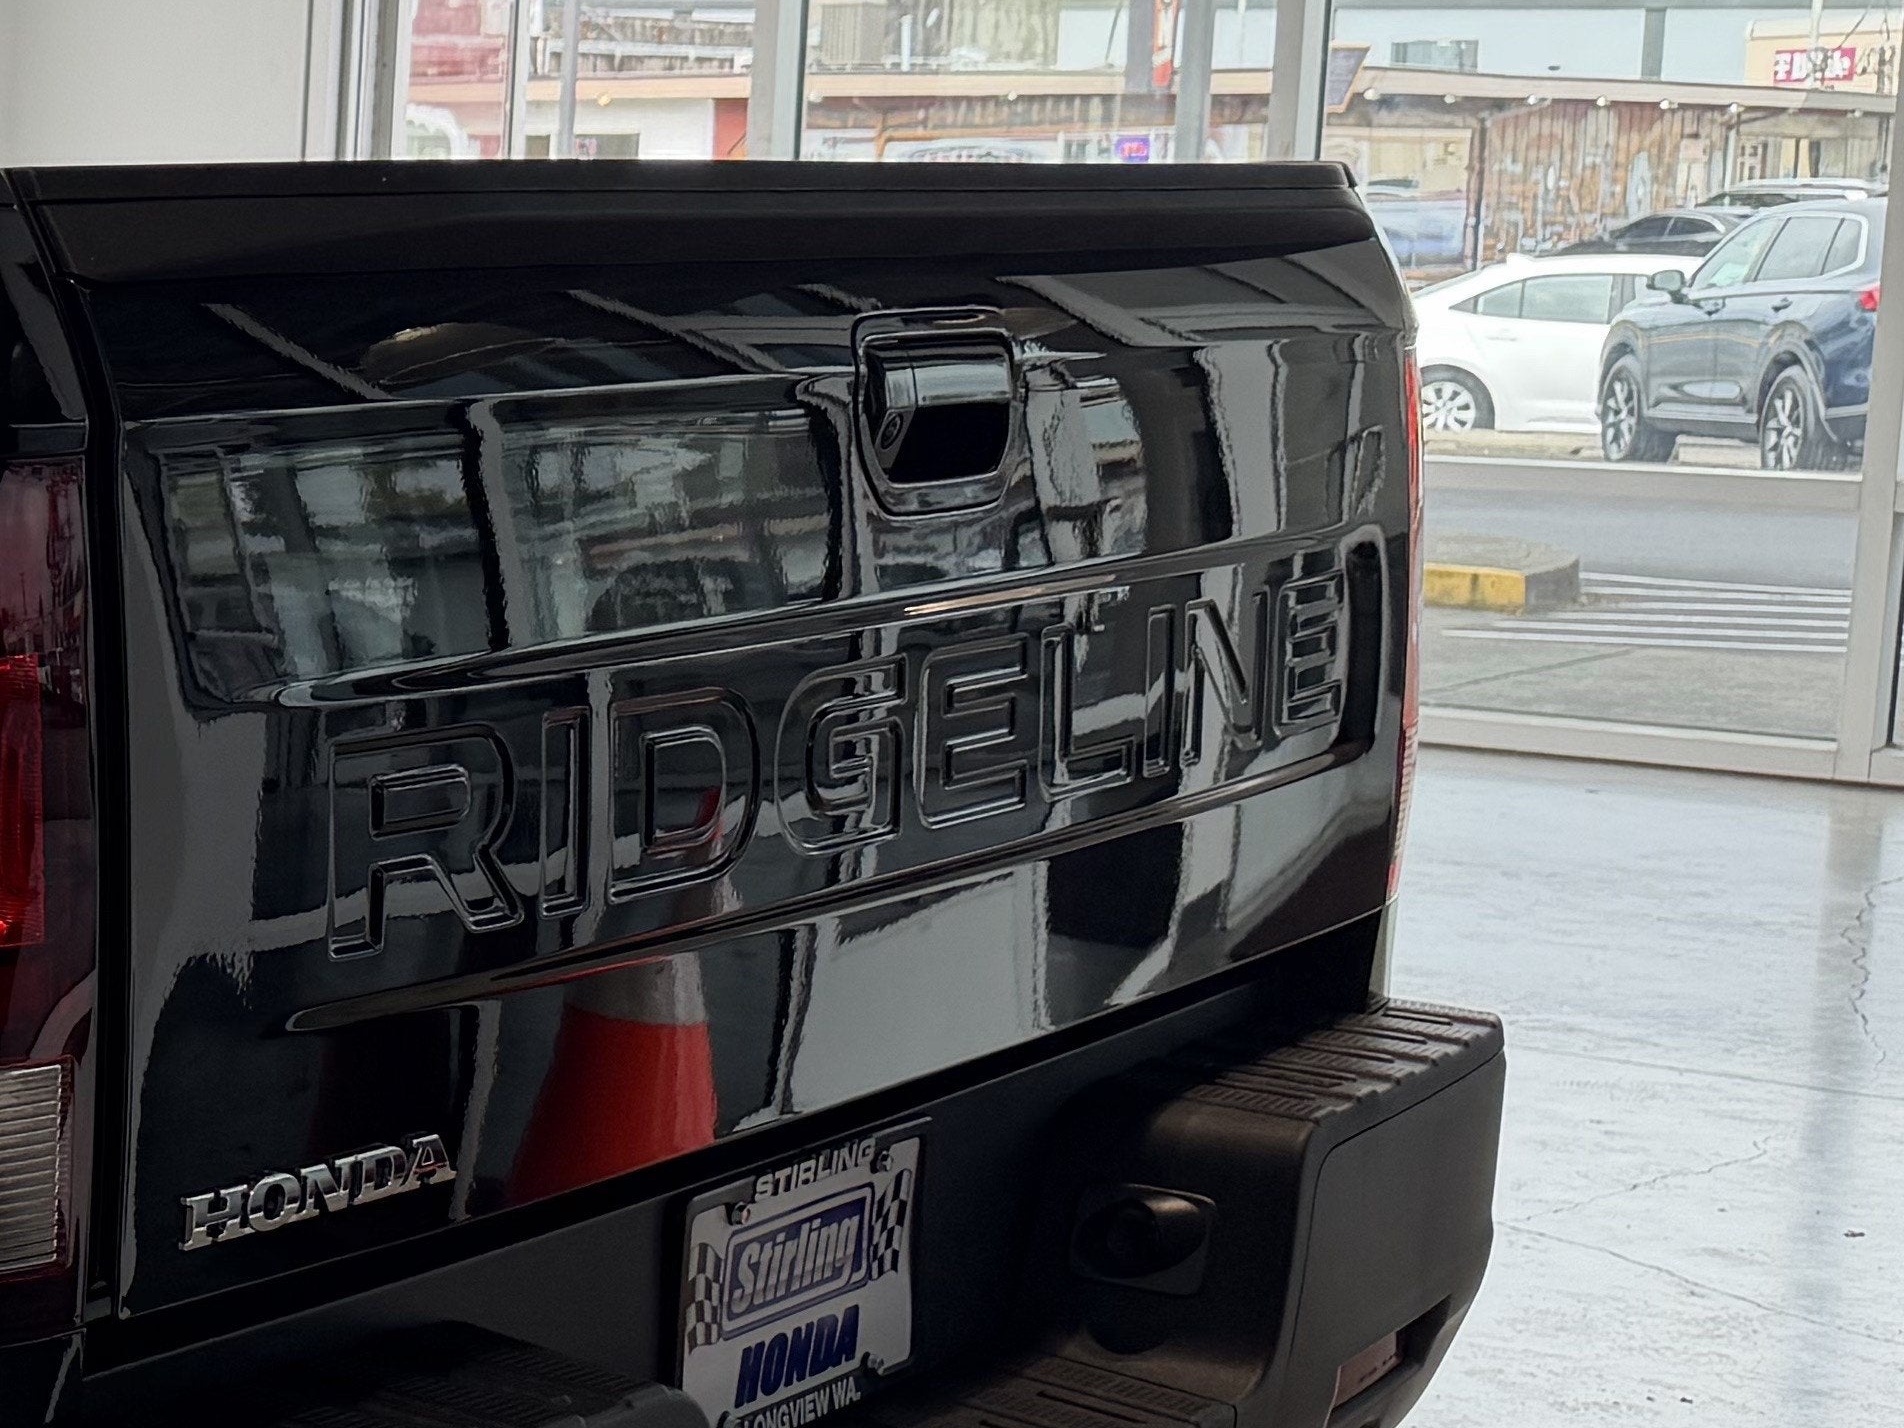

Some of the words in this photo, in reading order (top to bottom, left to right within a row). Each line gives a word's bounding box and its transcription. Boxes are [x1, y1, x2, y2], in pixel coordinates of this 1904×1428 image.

[326, 572, 1343, 959] RIDGELINE
[180, 1133, 457, 1252] HONDA
[754, 1137, 877, 1203] STIRLING
[731, 1214, 861, 1314] Stirling
[734, 1304, 860, 1409] HONDA
